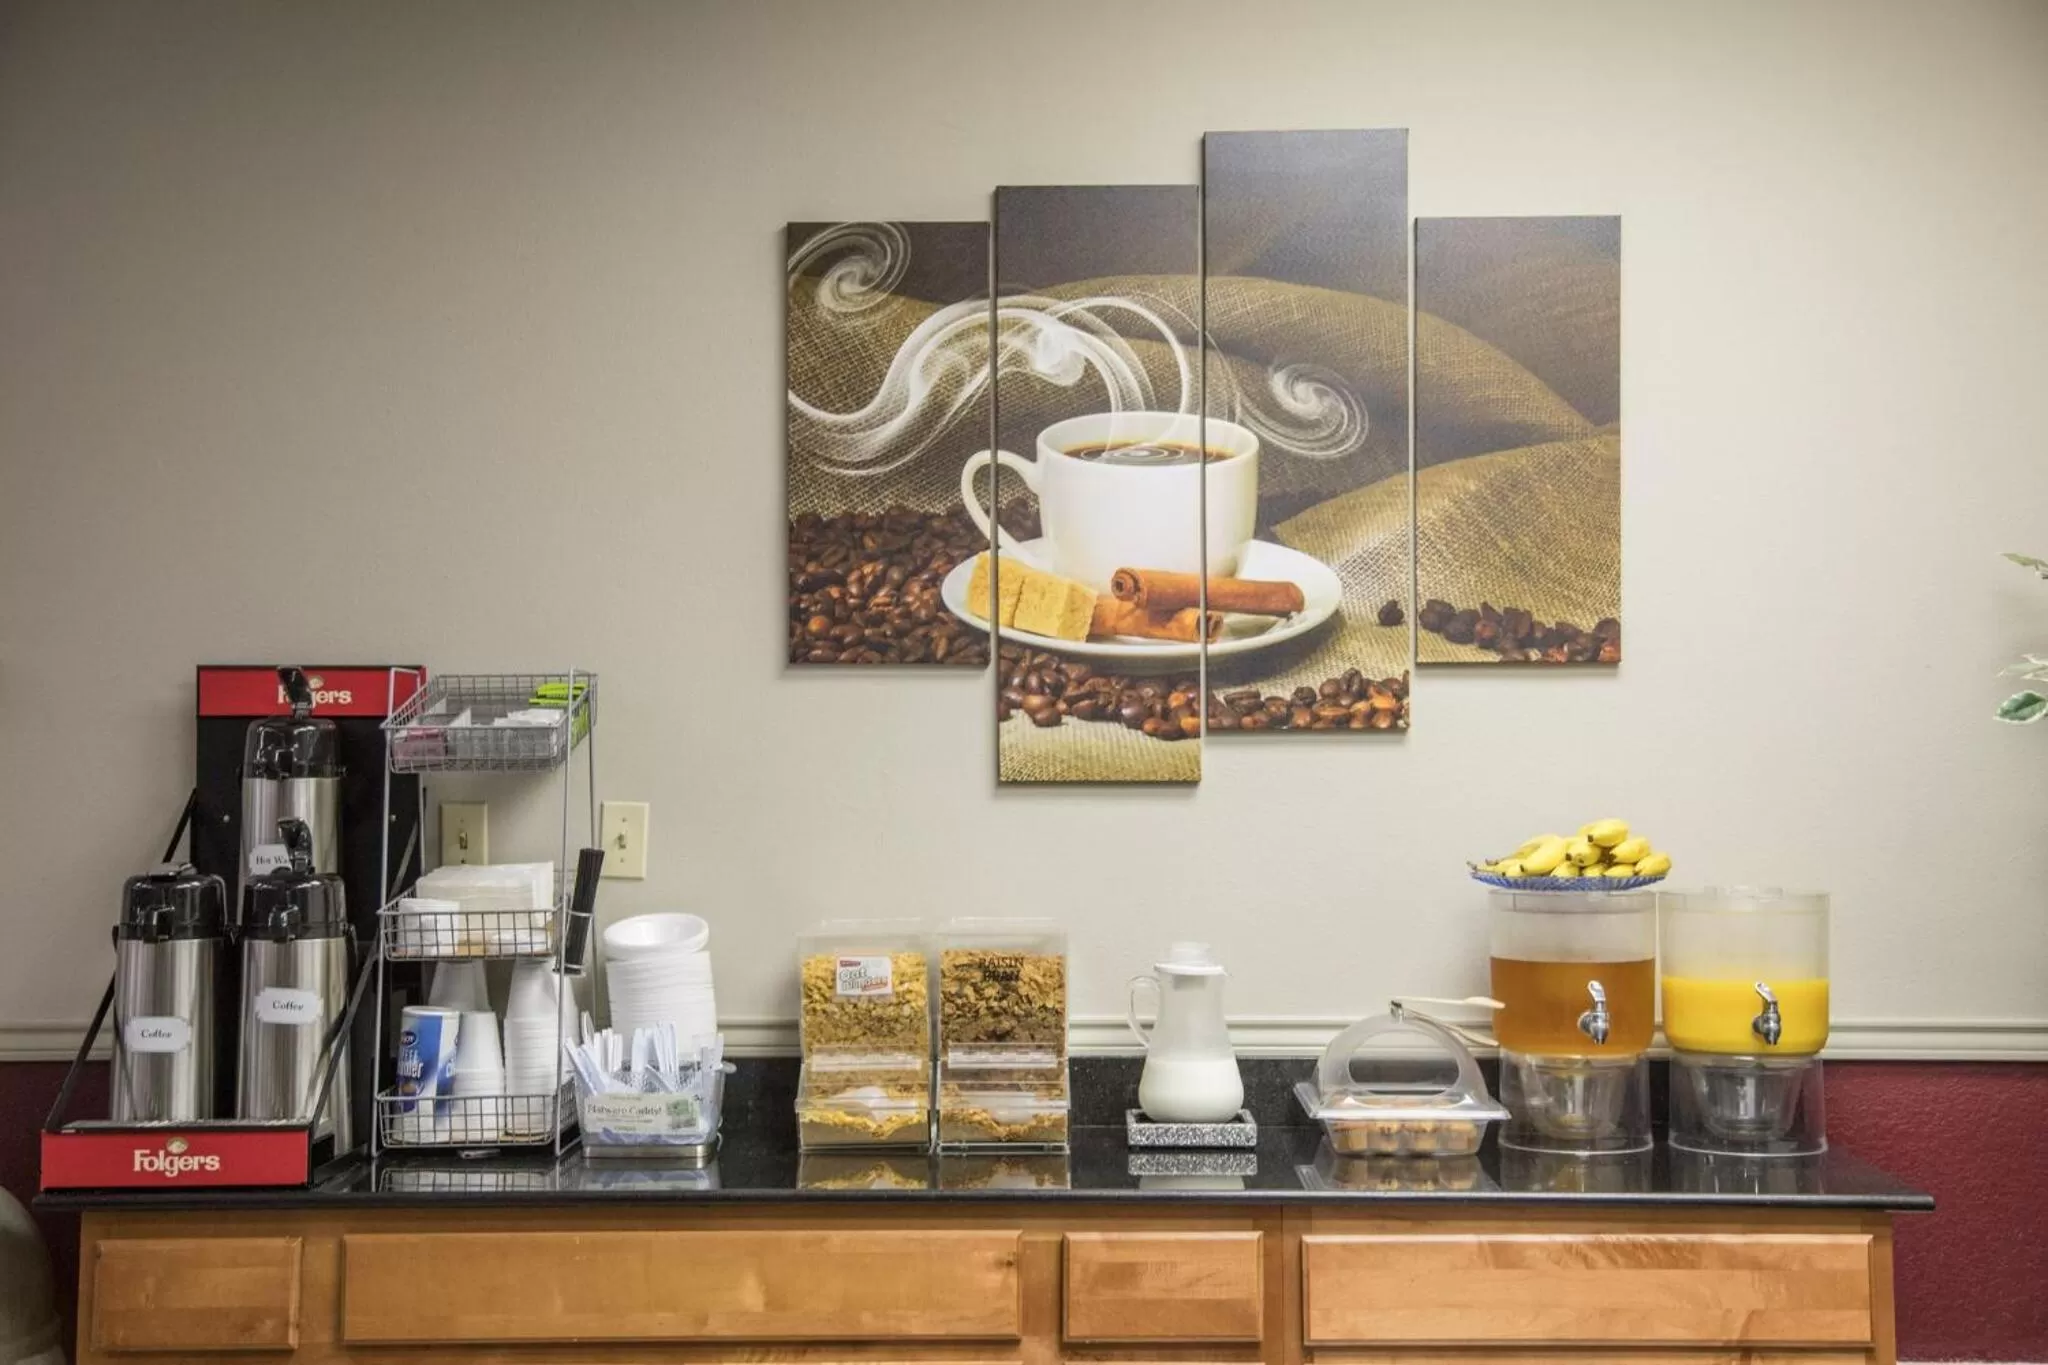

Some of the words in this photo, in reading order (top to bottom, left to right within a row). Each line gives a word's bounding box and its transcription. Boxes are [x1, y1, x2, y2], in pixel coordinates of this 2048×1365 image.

[979, 956, 1024, 968] RAISIN
[272, 999, 304, 1012] Coffee
[140, 1028, 173, 1040] Coffee
[133, 1149, 221, 1178] Folgers
